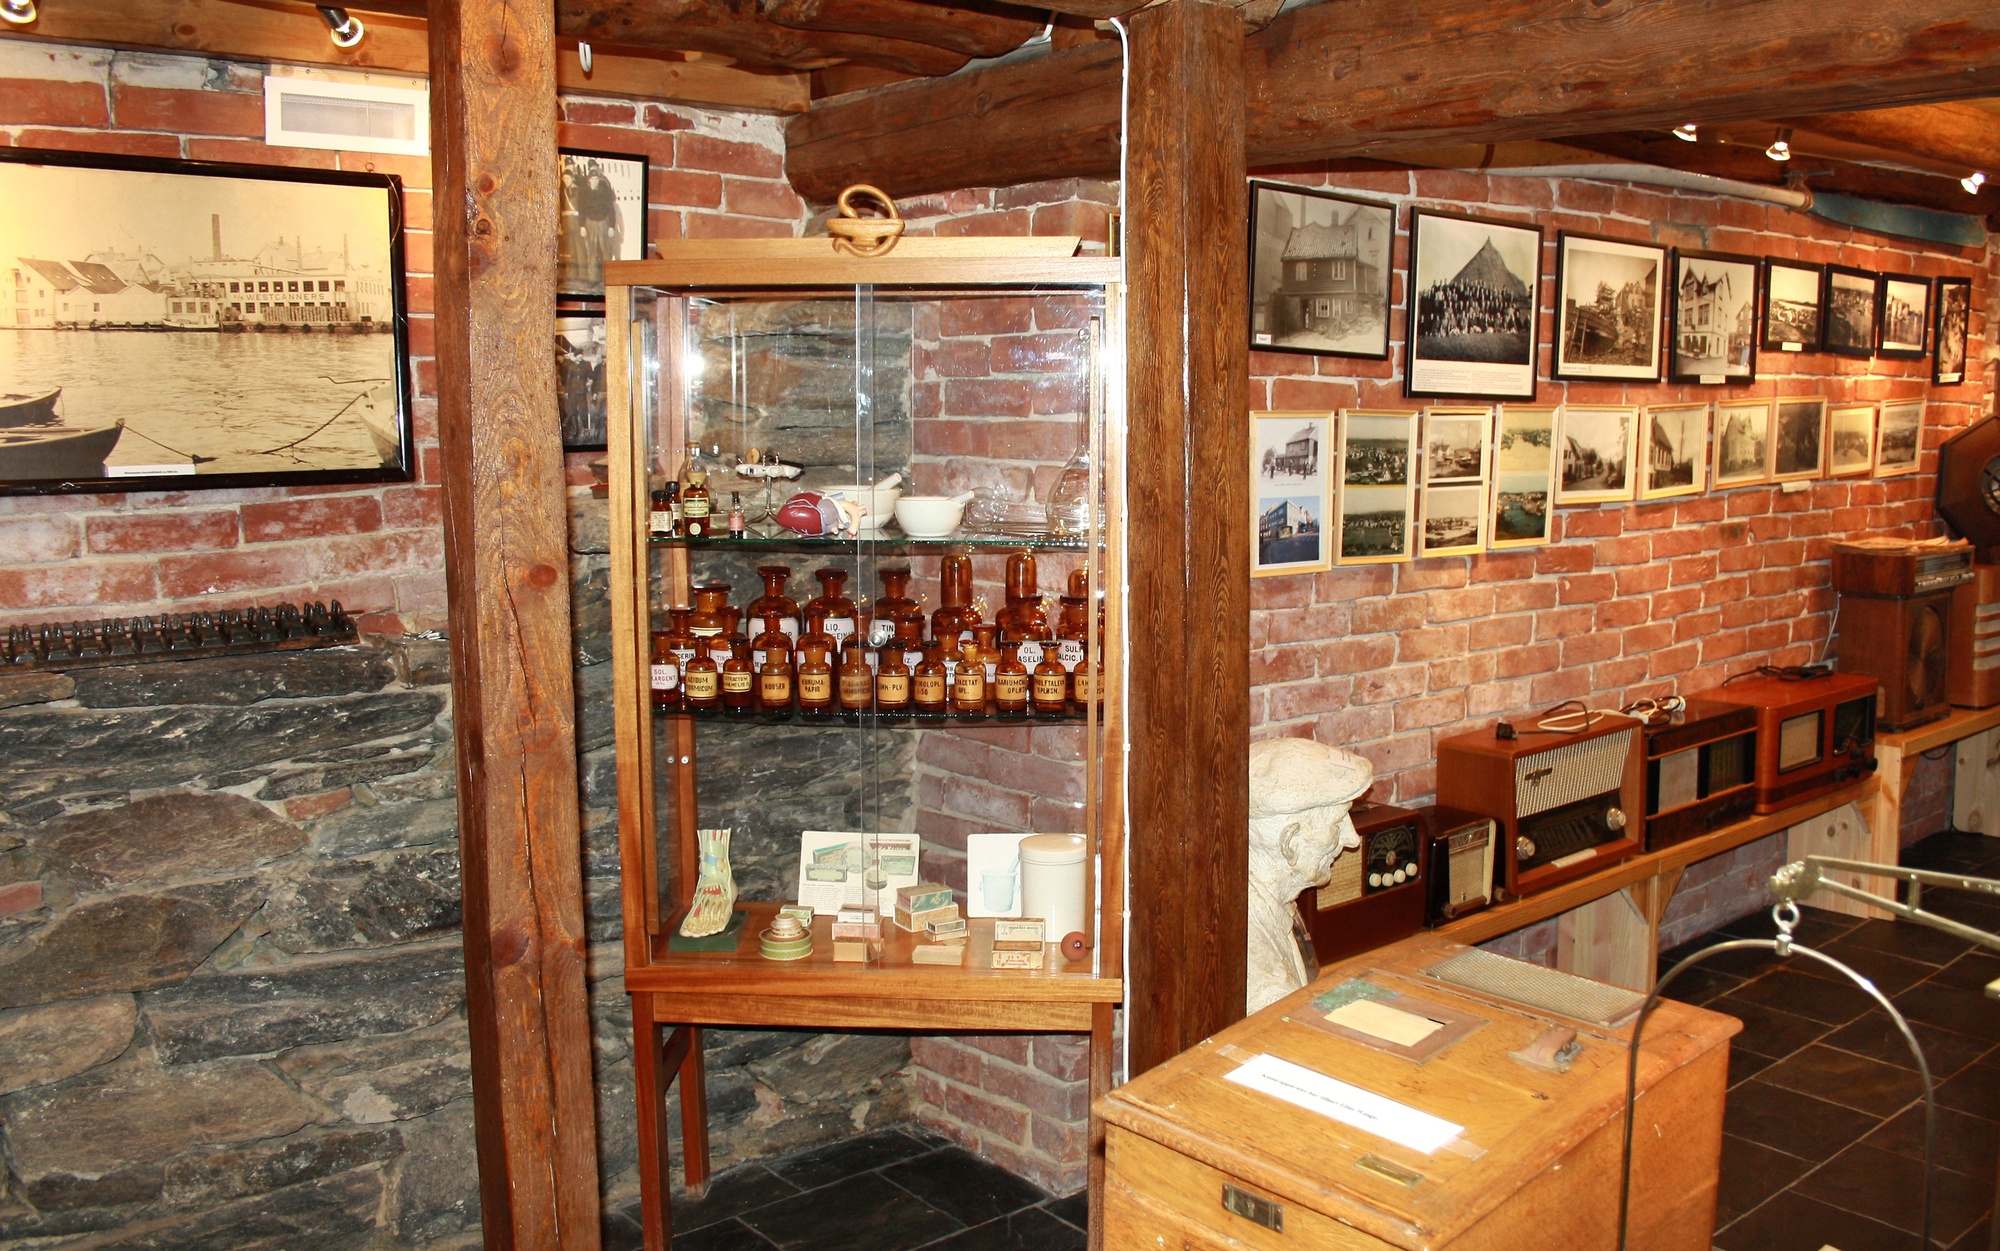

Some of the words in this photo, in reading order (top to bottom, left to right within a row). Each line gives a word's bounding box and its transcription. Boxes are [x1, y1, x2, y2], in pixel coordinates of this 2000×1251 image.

[246, 293, 325, 301] WESTCANNERS
[825, 623, 840, 631] LIQ.
[1023, 646, 1036, 654] OL.
